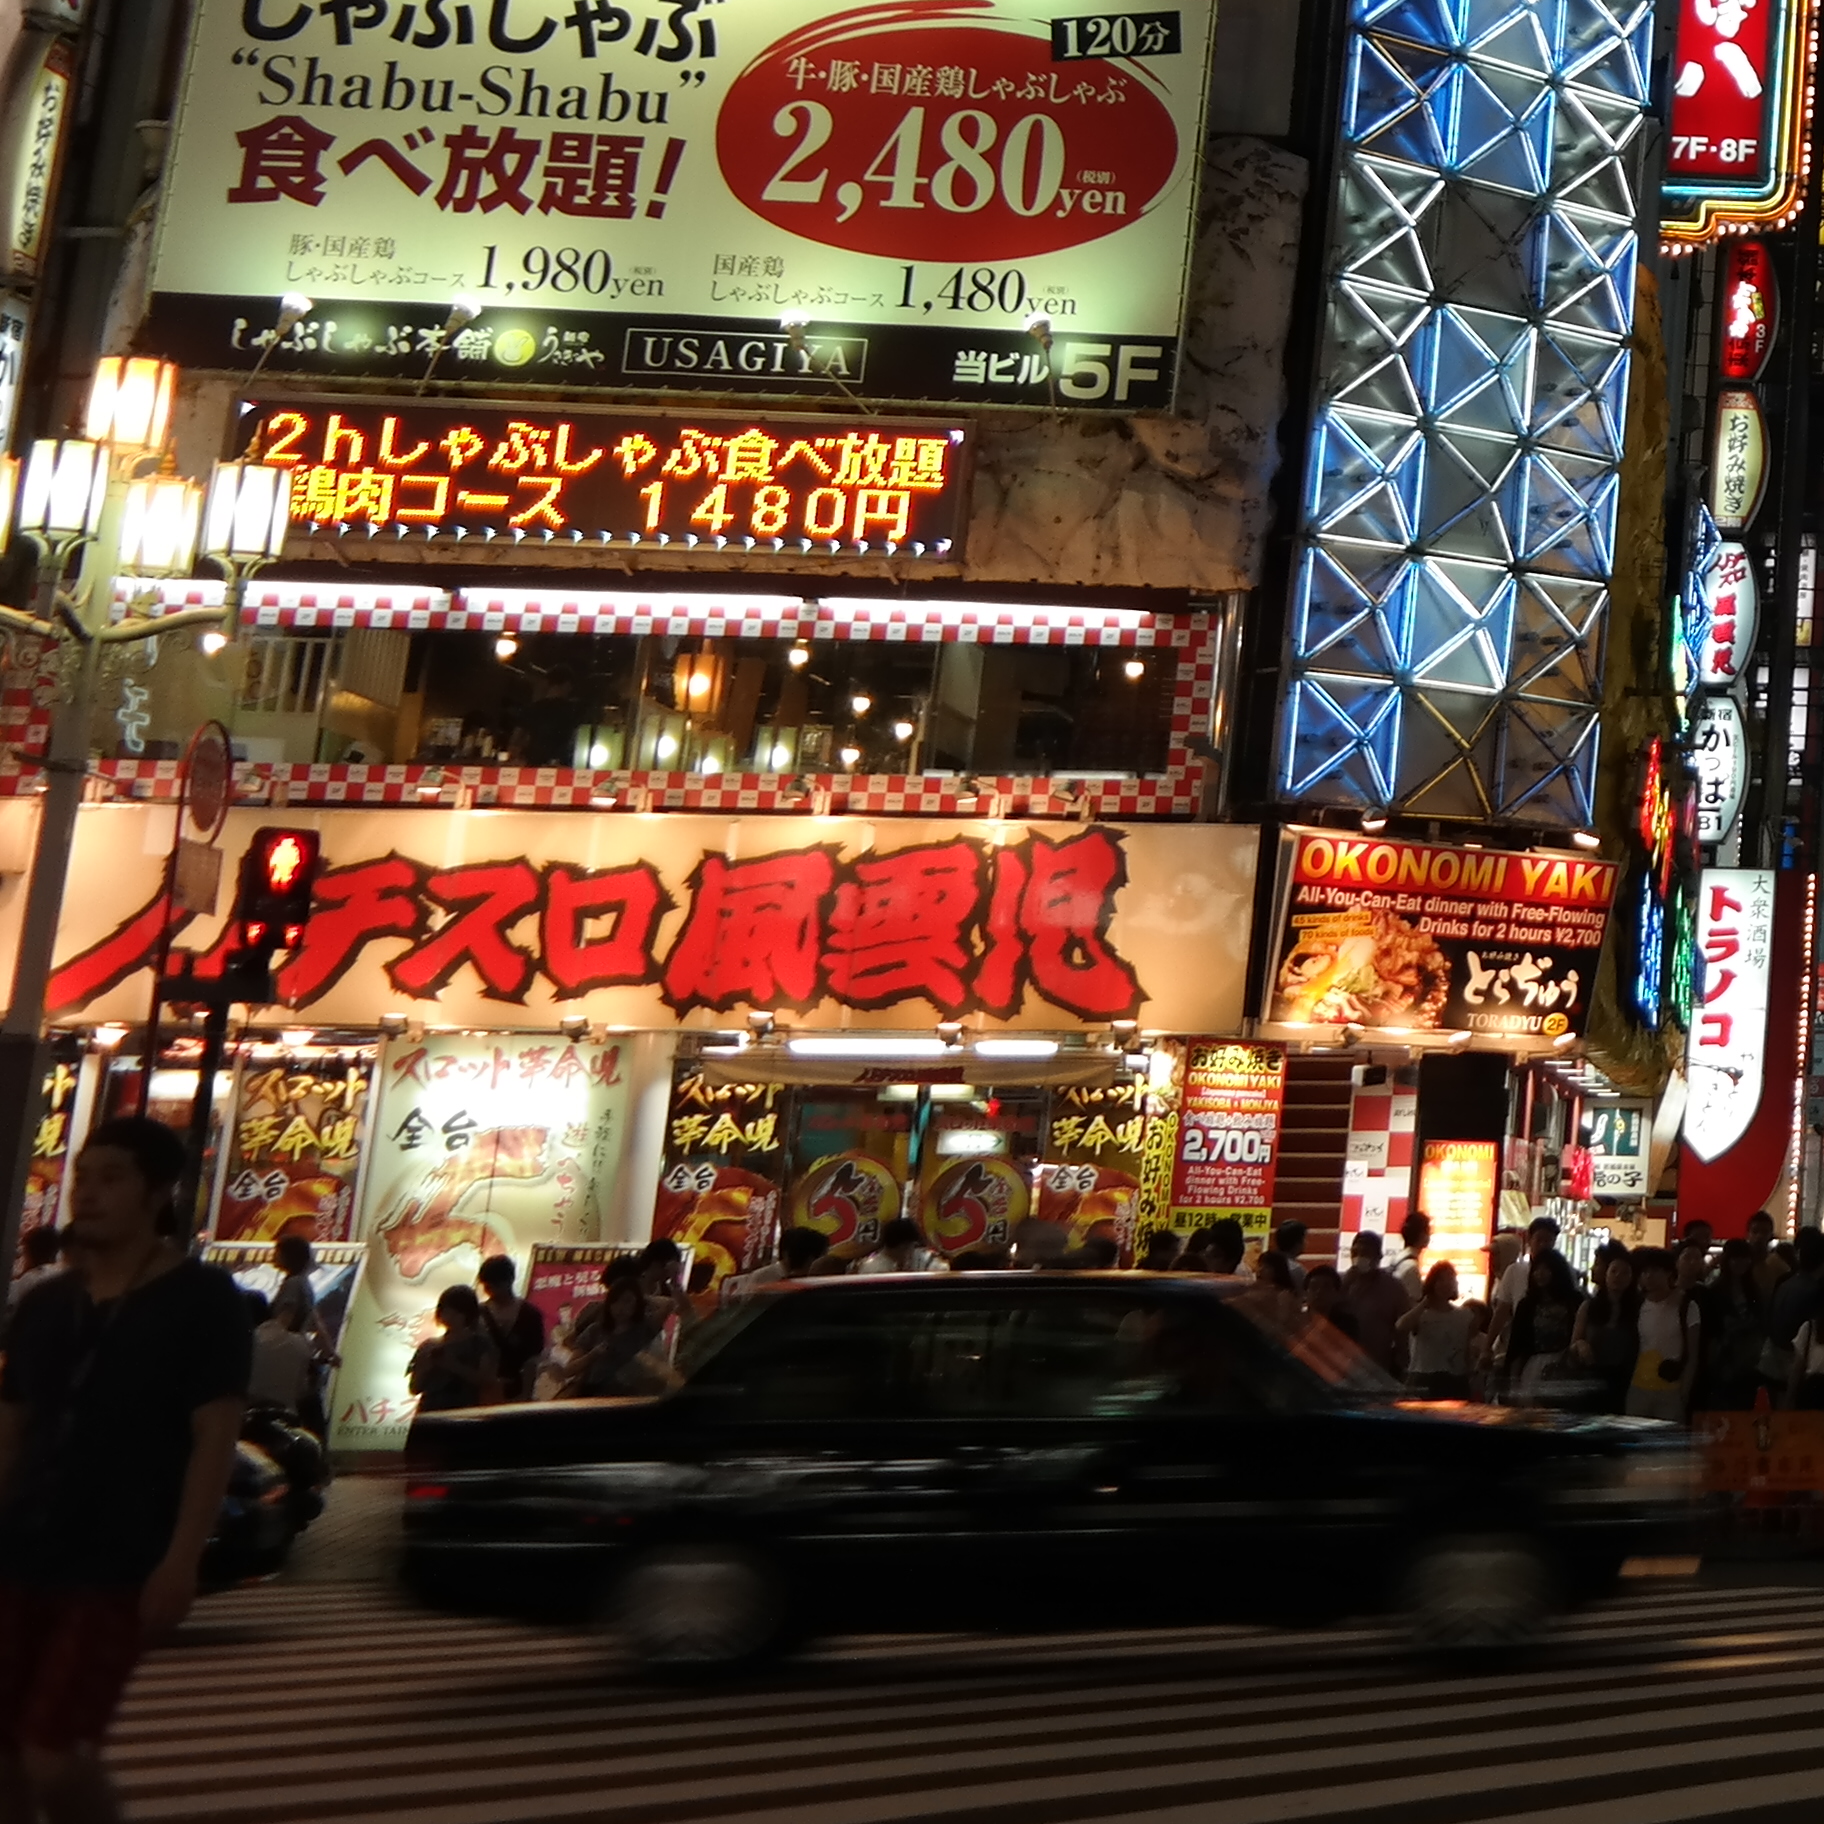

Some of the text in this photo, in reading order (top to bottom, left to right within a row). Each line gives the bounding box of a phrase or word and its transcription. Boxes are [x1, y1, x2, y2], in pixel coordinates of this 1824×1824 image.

[1062, 13, 1170, 59] 120分
[787, 56, 1129, 106] 牛・豚・国産鶏しゃぶしゃぶ
[227, 115, 687, 219] 食べ放題!
[762, 99, 1127, 224] 2,480 yen
[287, 232, 397, 260] 豚・国産鶏
[713, 253, 785, 278] 国産鶏
[286, 260, 466, 289] しゃぶしゃぶコース
[475, 244, 665, 300] 1,980 yen
[895, 265, 1078, 320] 1,480 yen
[709, 280, 886, 310] しゃぶしゃぶコース
[642, 335, 852, 377] USAGIYA
[953, 341, 1162, 402] 当ビル 5F
[1724, 415, 1750, 513] お好み焼き
[641, 483, 911, 544] 1480円
[1302, 838, 1615, 902] OKONOMI YAKI
[1297, 885, 1605, 927] All-You-Can-Eat dinner with Free-Flowing
[1746, 874, 1770, 970] 大衆酒場
[1418, 917, 1601, 947] Drinks for 2 hours ¥2,700
[1699, 884, 1742, 1048] トラノコ
[1467, 1012, 1566, 1032] TORADYU 2F
[1191, 1046, 1284, 1072] お好み焼き
[1188, 1074, 1282, 1089] OKONOMI YAKI
[391, 1107, 478, 1151] 全台
[1183, 1130, 1271, 1163] 2,700円
[1424, 1144, 1495, 1161] OKONOMI
[229, 1169, 288, 1201] 全台
